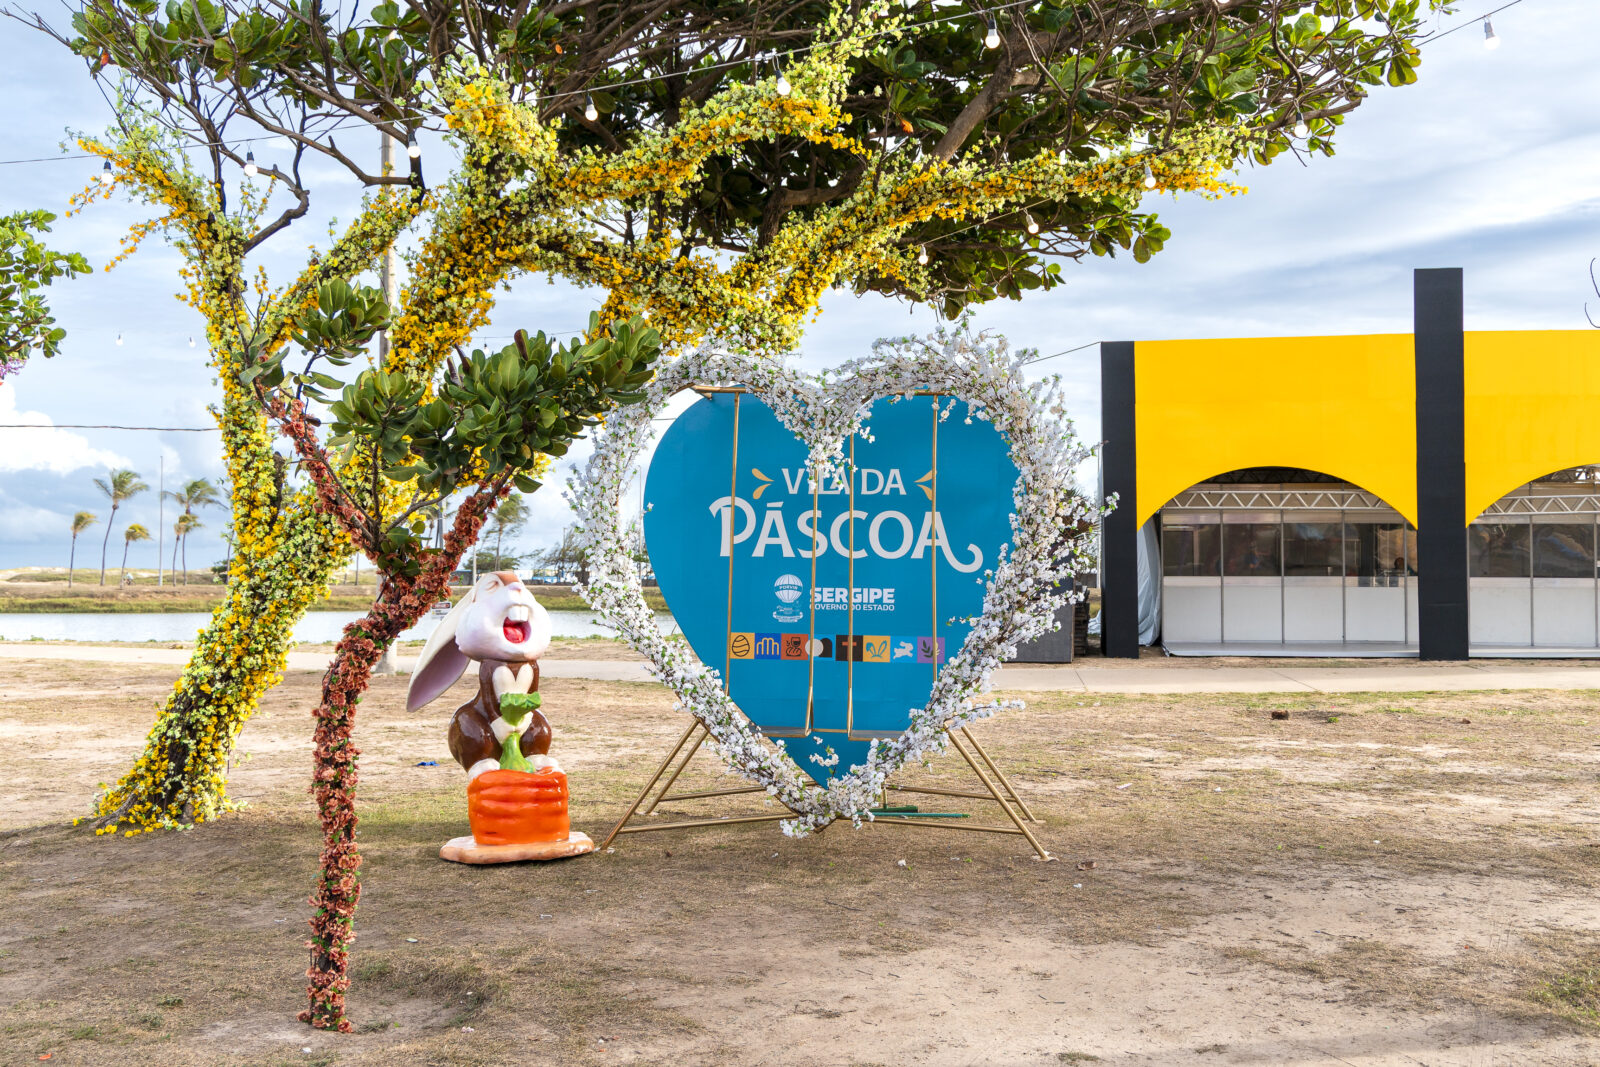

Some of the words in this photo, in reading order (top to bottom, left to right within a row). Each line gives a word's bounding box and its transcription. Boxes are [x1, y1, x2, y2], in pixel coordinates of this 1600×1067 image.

[861, 468, 907, 495] DA
[708, 495, 983, 573] PÁSCOA
[809, 587, 895, 604] SERGIPE
